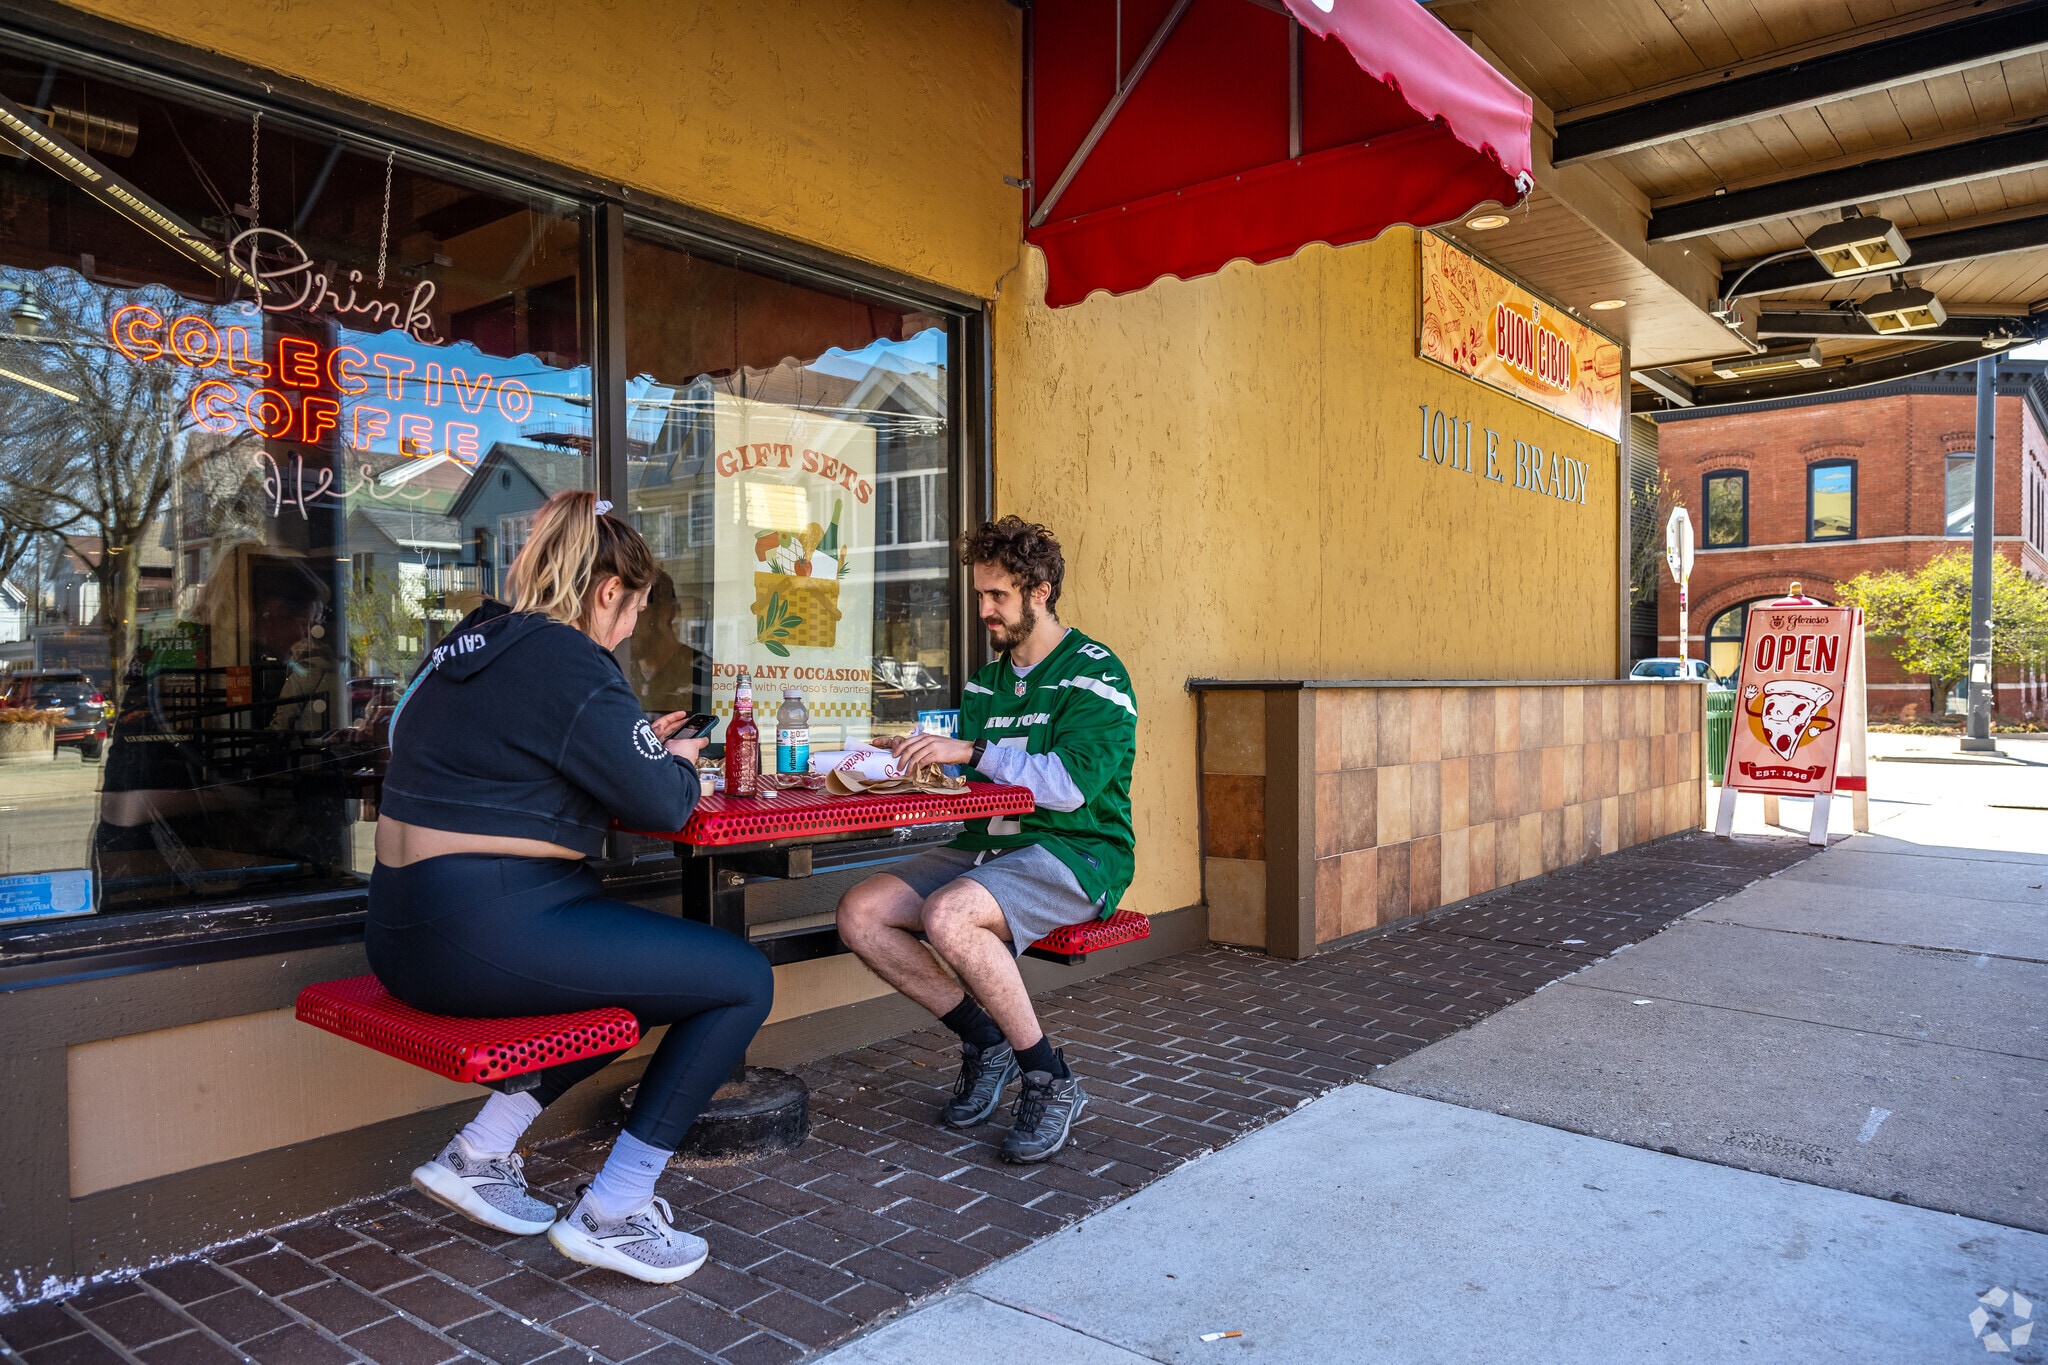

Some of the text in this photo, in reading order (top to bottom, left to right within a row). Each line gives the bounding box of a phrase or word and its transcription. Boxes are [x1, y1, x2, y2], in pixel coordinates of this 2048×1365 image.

[228, 227, 444, 345] Drink
[111, 304, 533, 424] COLECTIVO
[1496, 303, 1571, 392] BUON CIBO!
[191, 379, 480, 465] COFFEE
[715, 442, 873, 505] GIFT SETS
[1419, 404, 1591, 505] 1011 E. BRADY
[253, 449, 431, 522] Here
[150, 640, 192, 650] FLYER
[1755, 634, 1839, 673] OPEN
[712, 681, 870, 694] pack with Glorioso's favorites
[713, 663, 871, 682] FOR ANY OCCASION
[923, 714, 958, 734] ATM
[984, 716, 1015, 730] EW
[1755, 769, 1808, 780] EST. 1946
[18, 903, 51, 913] SYSTEM
